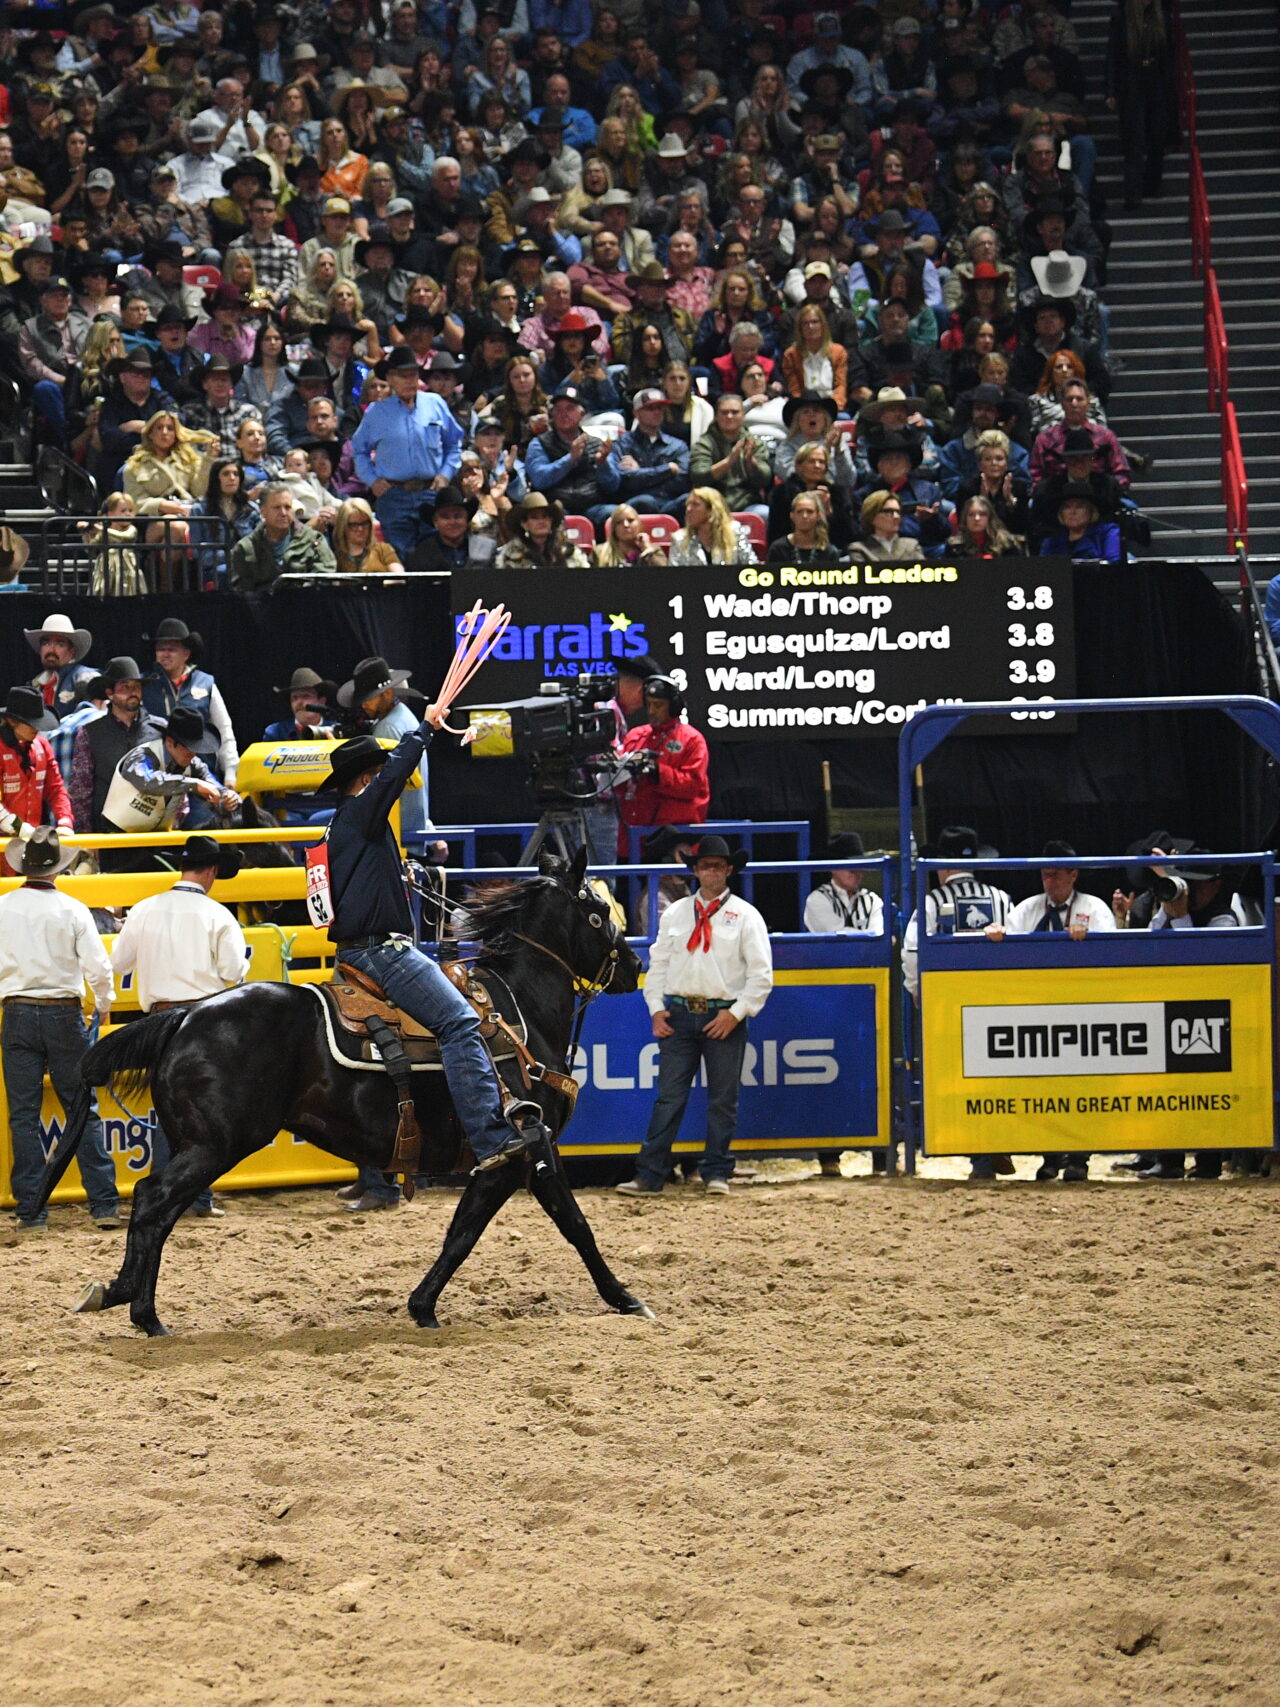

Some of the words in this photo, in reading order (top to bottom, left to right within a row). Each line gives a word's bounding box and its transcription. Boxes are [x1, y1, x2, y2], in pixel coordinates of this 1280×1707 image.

[739, 568, 774, 587] Go
[780, 565, 858, 587] Round
[865, 564, 958, 584] Leaders
[669, 595, 683, 619] 1
[704, 592, 892, 619] Wade/Thorp
[1007, 586, 1054, 611] 3.8
[669, 632, 684, 655] 1
[706, 625, 951, 660] Egusquiza/Lord
[1008, 622, 1055, 647] 3.8
[544, 662, 579, 677] LAS
[582, 661, 619, 675] VEG
[705, 665, 875, 693] Ward/Long
[1009, 659, 1056, 684] 3.9
[707, 698, 963, 728] Summers/Cor
[270, 753, 330, 774] PRODUCT
[307, 864, 327, 887] FR
[1171, 1018, 1225, 1055] CAT
[566, 1038, 839, 1091] LARIS
[966, 1099, 1016, 1115] MORE
[1021, 1098, 1071, 1114] THAN
[1076, 1096, 1132, 1113] GREAT
[1137, 1094, 1232, 1112] MACHINES
